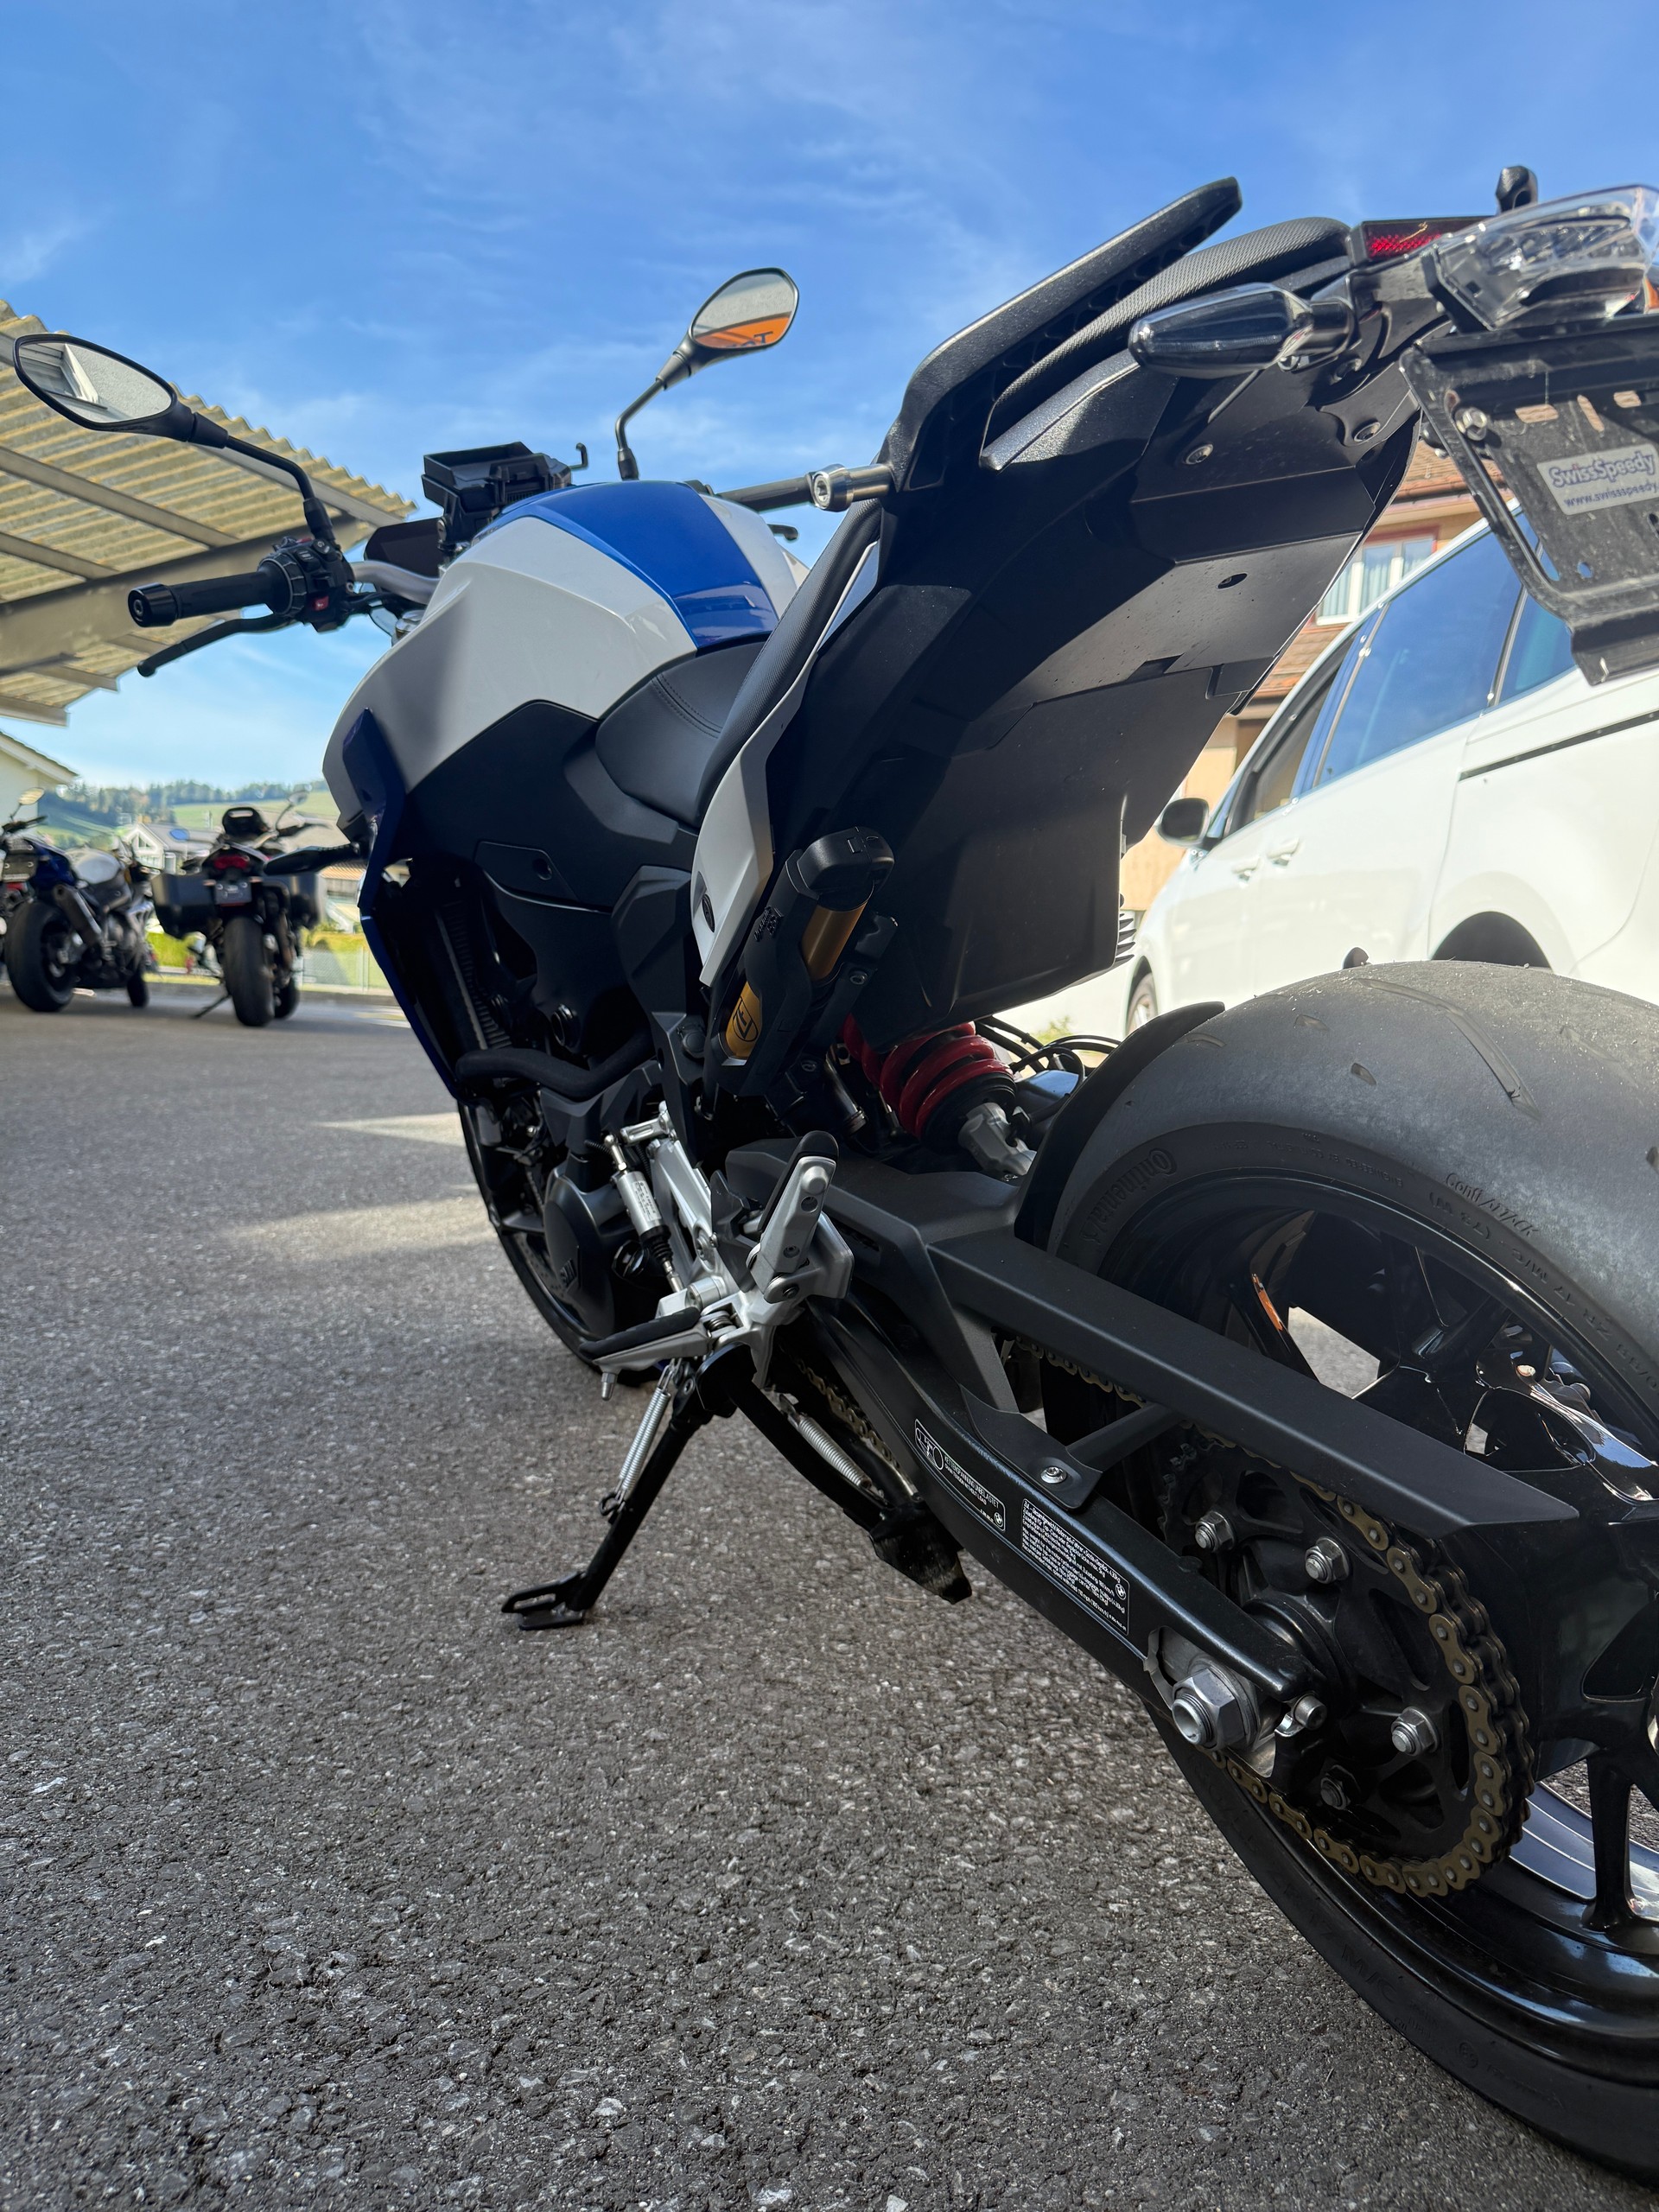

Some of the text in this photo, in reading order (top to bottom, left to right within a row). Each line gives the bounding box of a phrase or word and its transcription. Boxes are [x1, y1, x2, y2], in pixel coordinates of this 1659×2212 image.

[1548, 450, 1656, 488] SwissSpeedy
[734, 1007, 754, 1039] ZF
[1086, 1147, 1177, 1231] Continental
